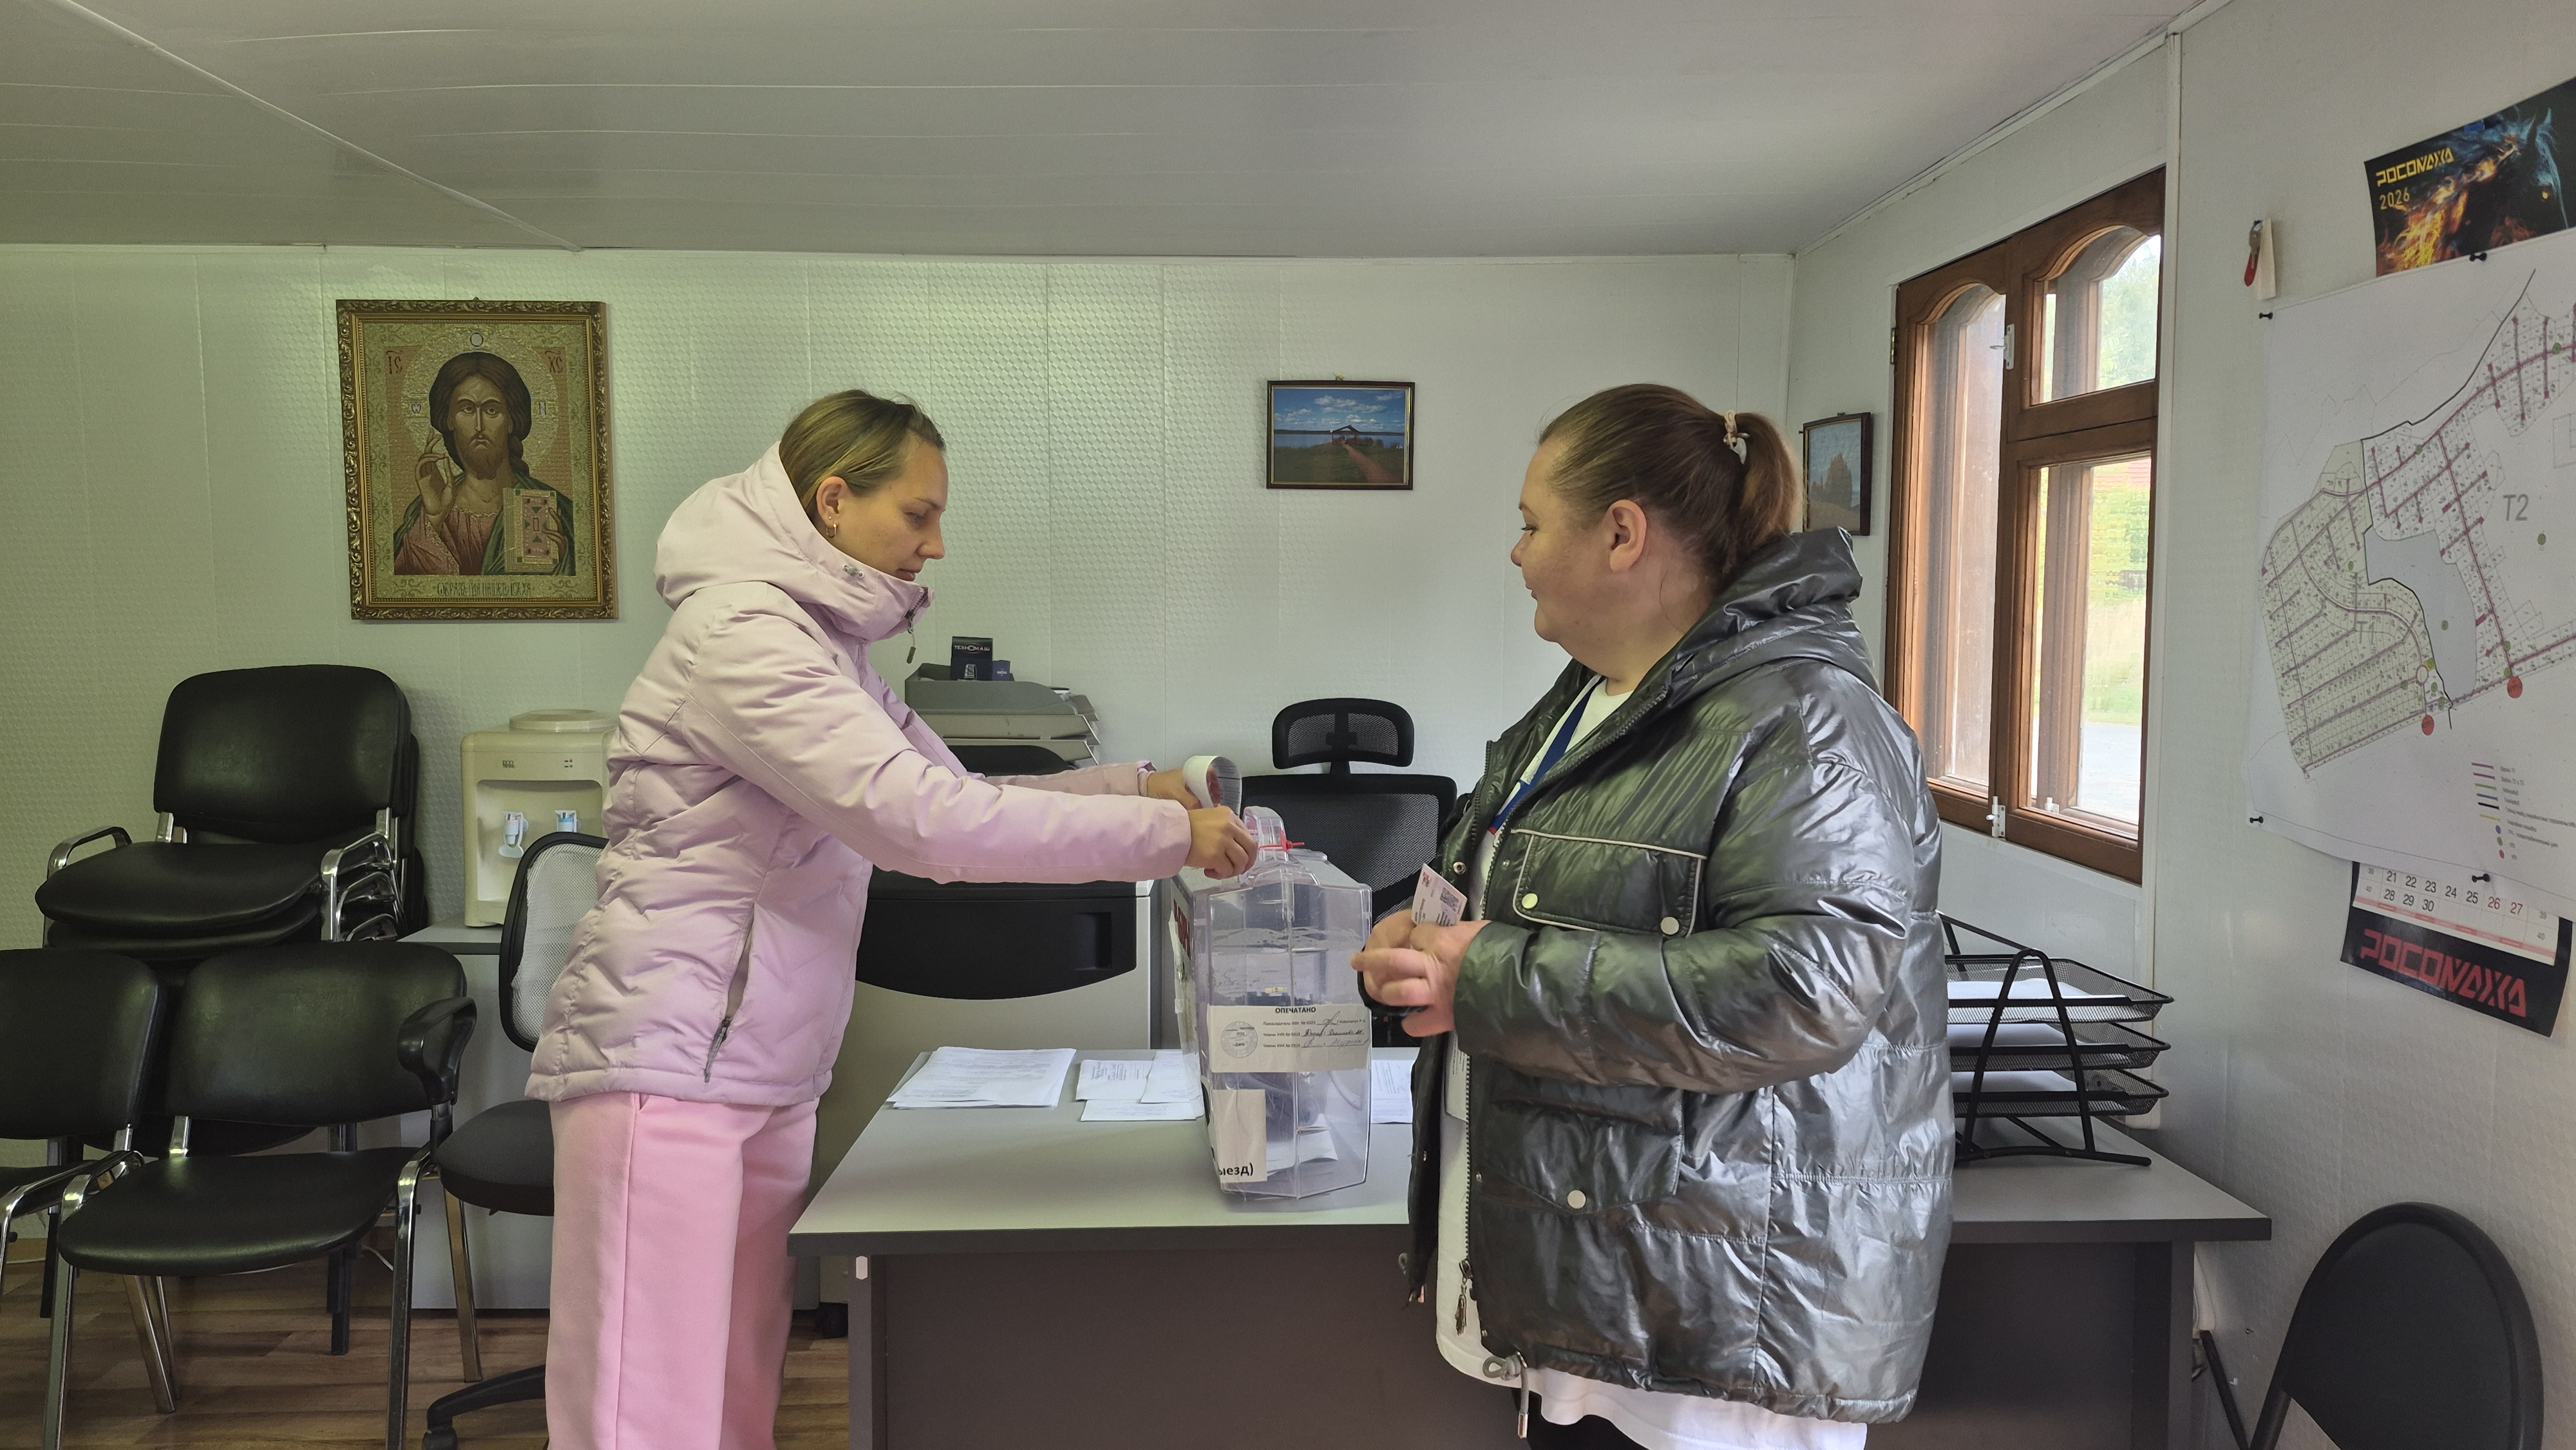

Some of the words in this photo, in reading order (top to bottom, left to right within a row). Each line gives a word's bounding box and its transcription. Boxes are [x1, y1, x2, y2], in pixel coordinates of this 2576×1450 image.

[2380, 187, 2410, 210] 2026
[2384, 889, 2395, 901] 28
[2403, 894, 2414, 906] 29
[2422, 899, 2434, 912] 30
[2386, 871, 2396, 883] 21
[2405, 876, 2417, 888] 22
[2425, 880, 2436, 893] 23
[2445, 885, 2457, 898] 24
[2466, 890, 2479, 904] 25
[2488, 896, 2501, 910] 26
[2510, 902, 2523, 915] 27
